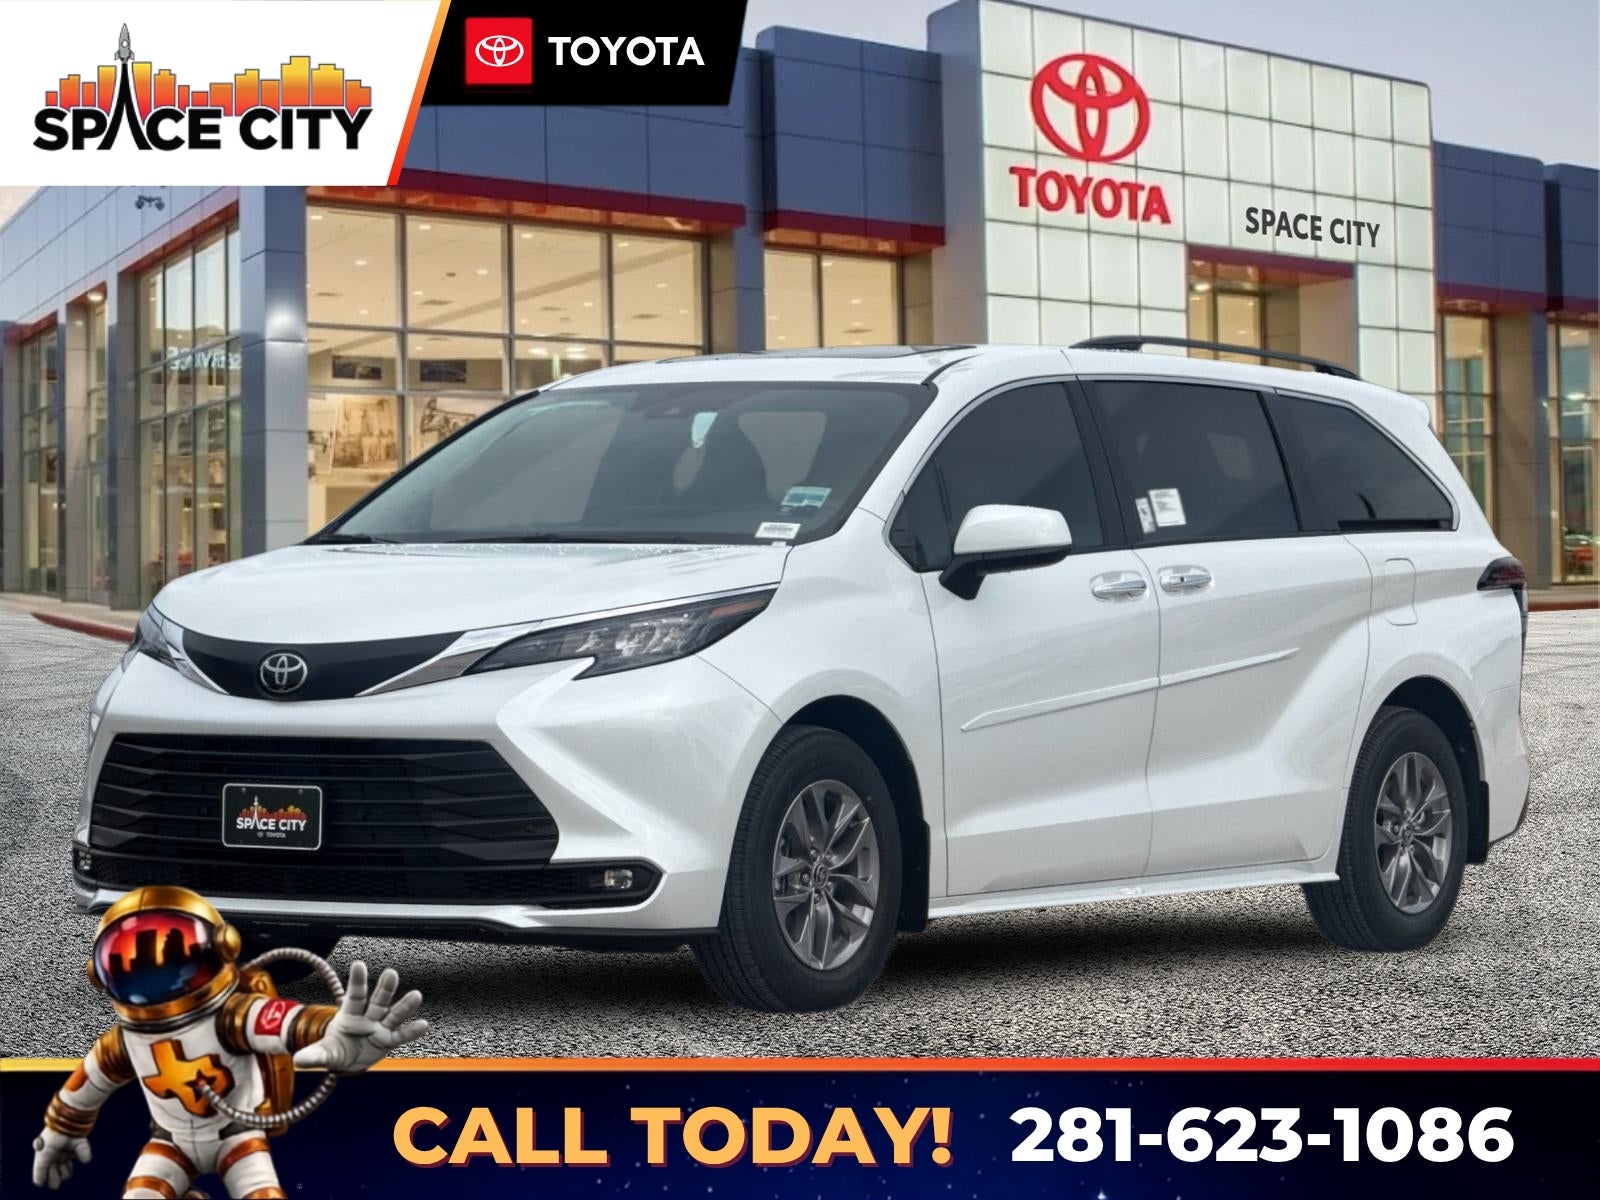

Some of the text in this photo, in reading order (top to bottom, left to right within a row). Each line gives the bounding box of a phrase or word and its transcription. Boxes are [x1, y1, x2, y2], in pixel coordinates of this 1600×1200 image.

[1009, 166, 1171, 224] TOYOTA
[1245, 206, 1381, 248] SPACE CITY
[236, 817, 306, 831] SPACE CITY
